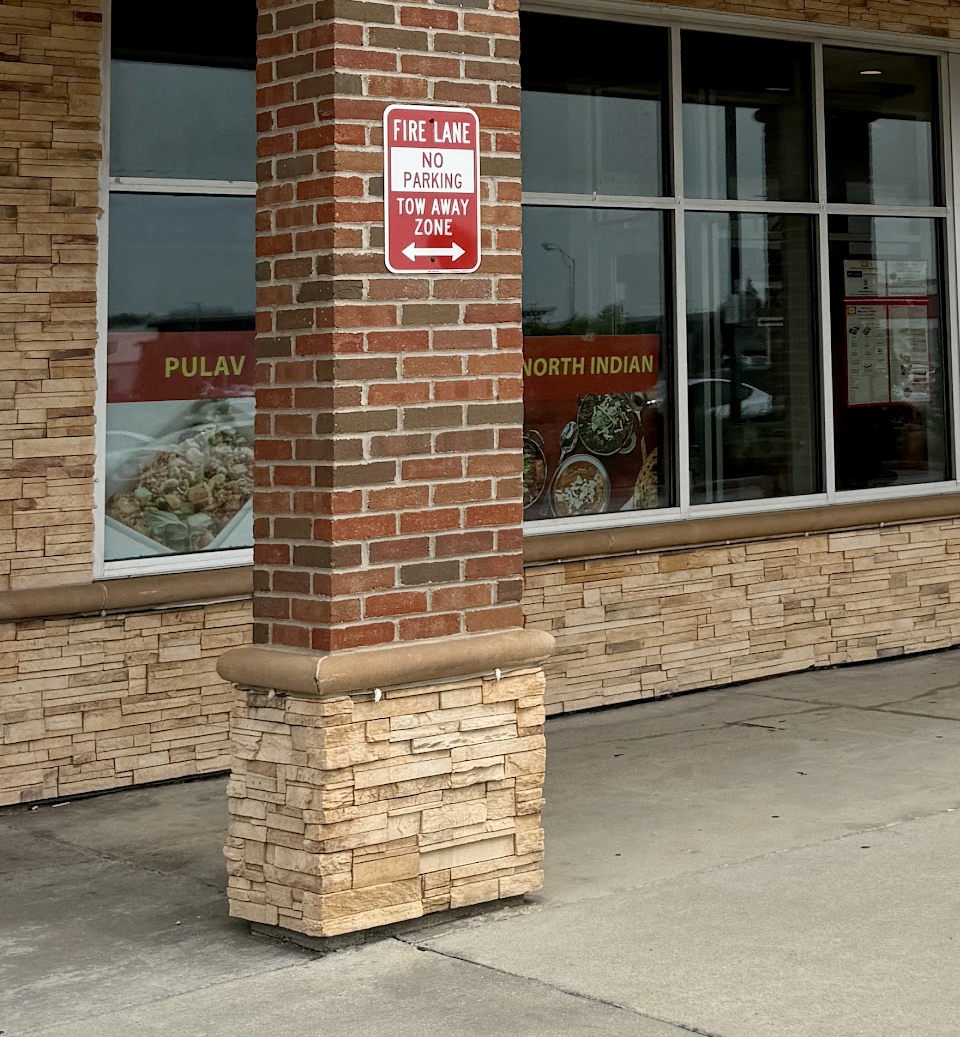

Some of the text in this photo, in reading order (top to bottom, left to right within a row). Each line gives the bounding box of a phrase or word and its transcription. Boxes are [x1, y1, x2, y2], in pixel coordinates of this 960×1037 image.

[393, 119, 471, 144] FIRE LANE
[422, 152, 443, 168] NO
[404, 172, 462, 189] PARKING
[397, 198, 469, 215] TOW AWAY
[414, 219, 452, 236] ZONE
[165, 355, 246, 378] PULAV
[523, 354, 653, 377] NORTH INDIAN
